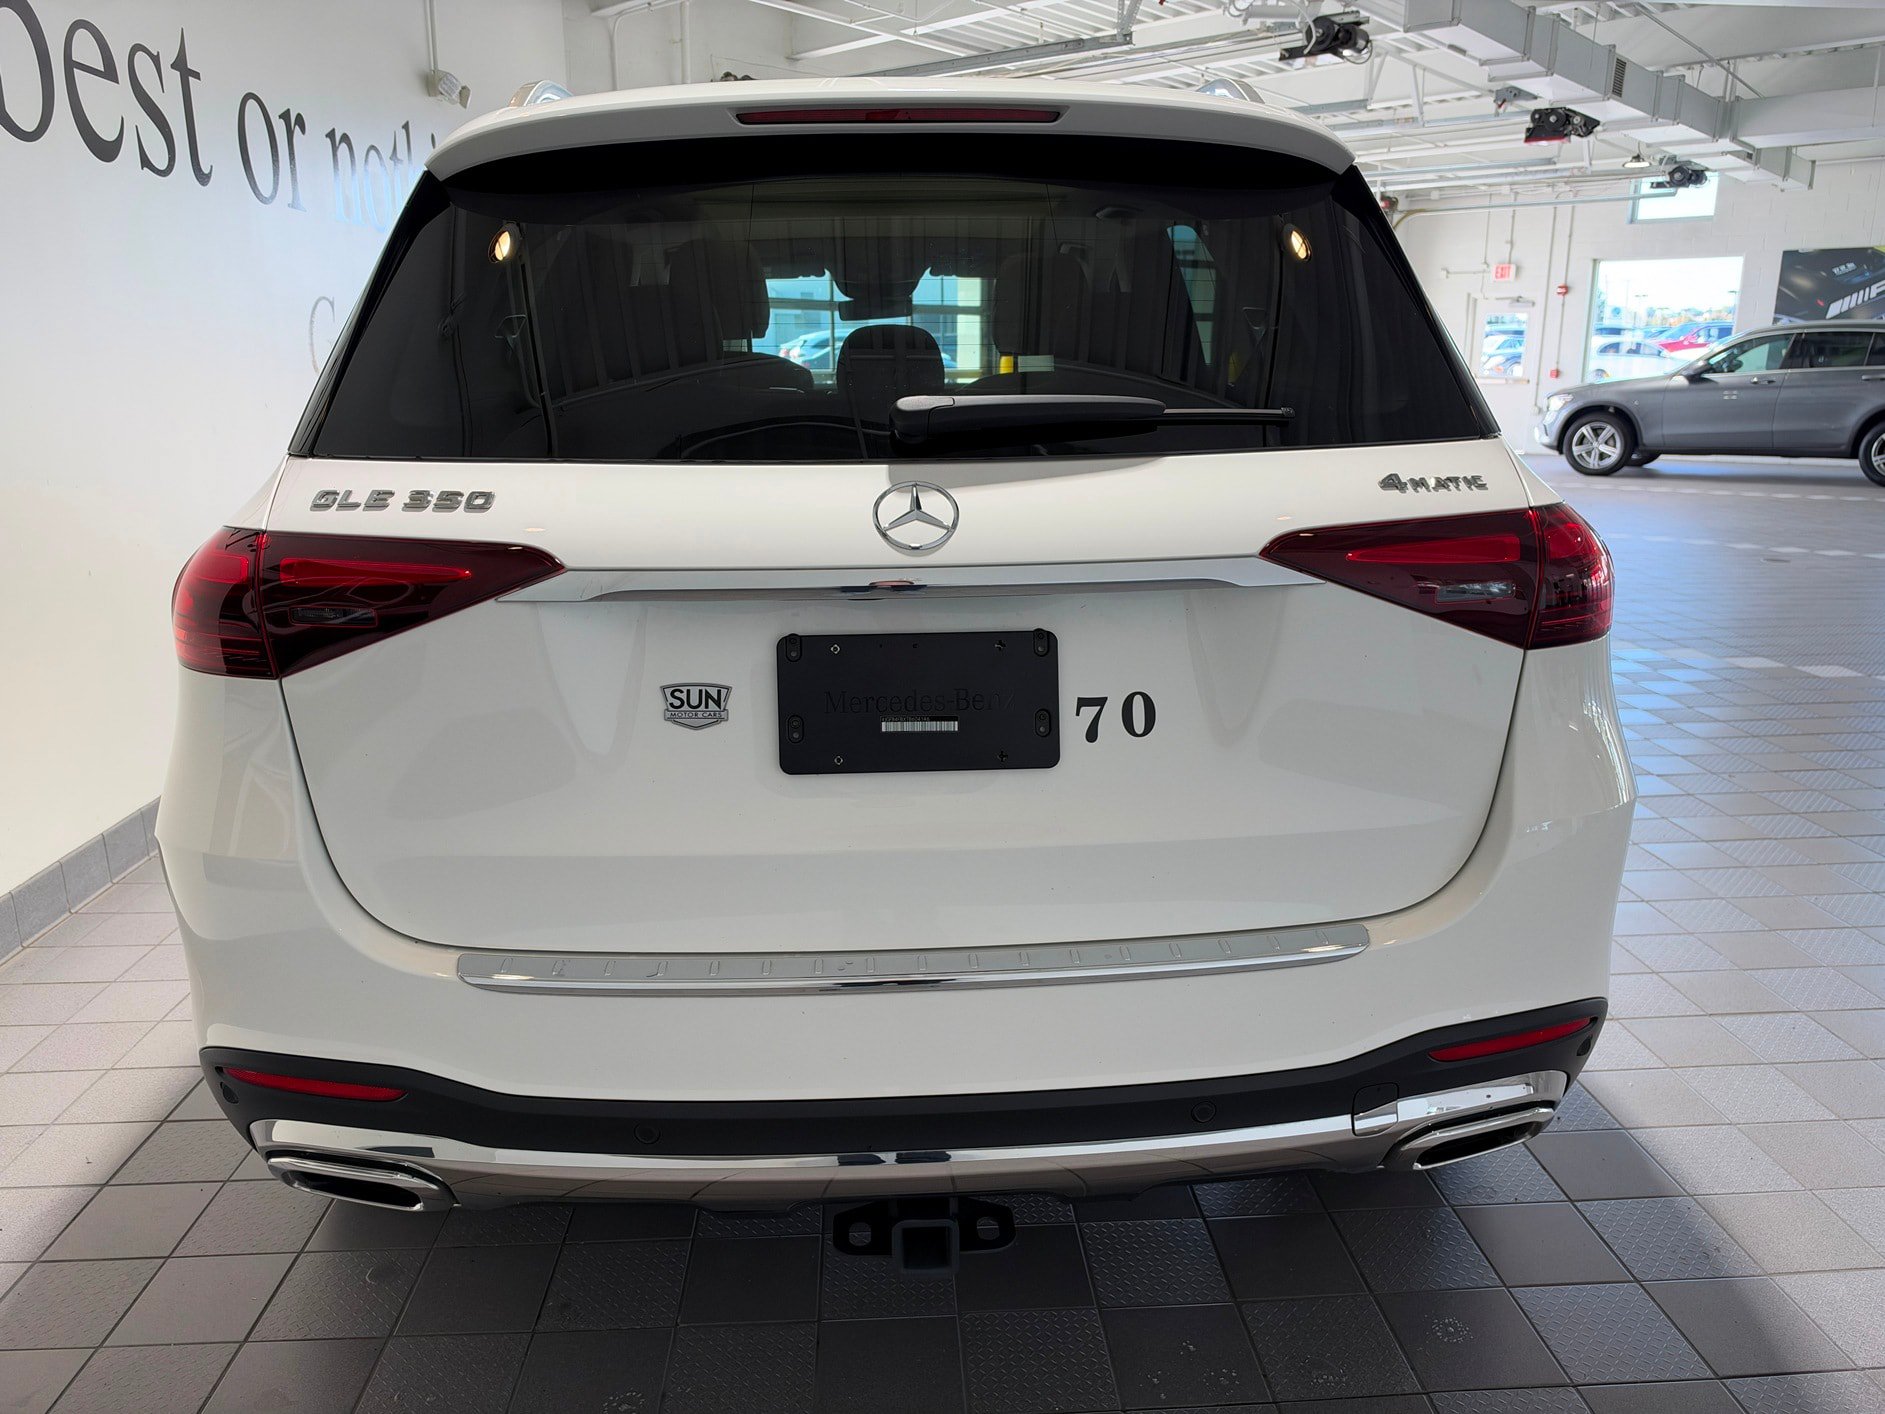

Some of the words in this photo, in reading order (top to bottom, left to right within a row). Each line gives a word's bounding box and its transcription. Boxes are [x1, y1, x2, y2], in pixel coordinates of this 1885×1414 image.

[238, 92, 307, 213] or
[1377, 472, 1489, 494] 4MATIC
[309, 489, 395, 512] GLE
[401, 489, 497, 513] 350
[669, 688, 722, 710] SUN
[823, 687, 1016, 714] Mercedes-Benz
